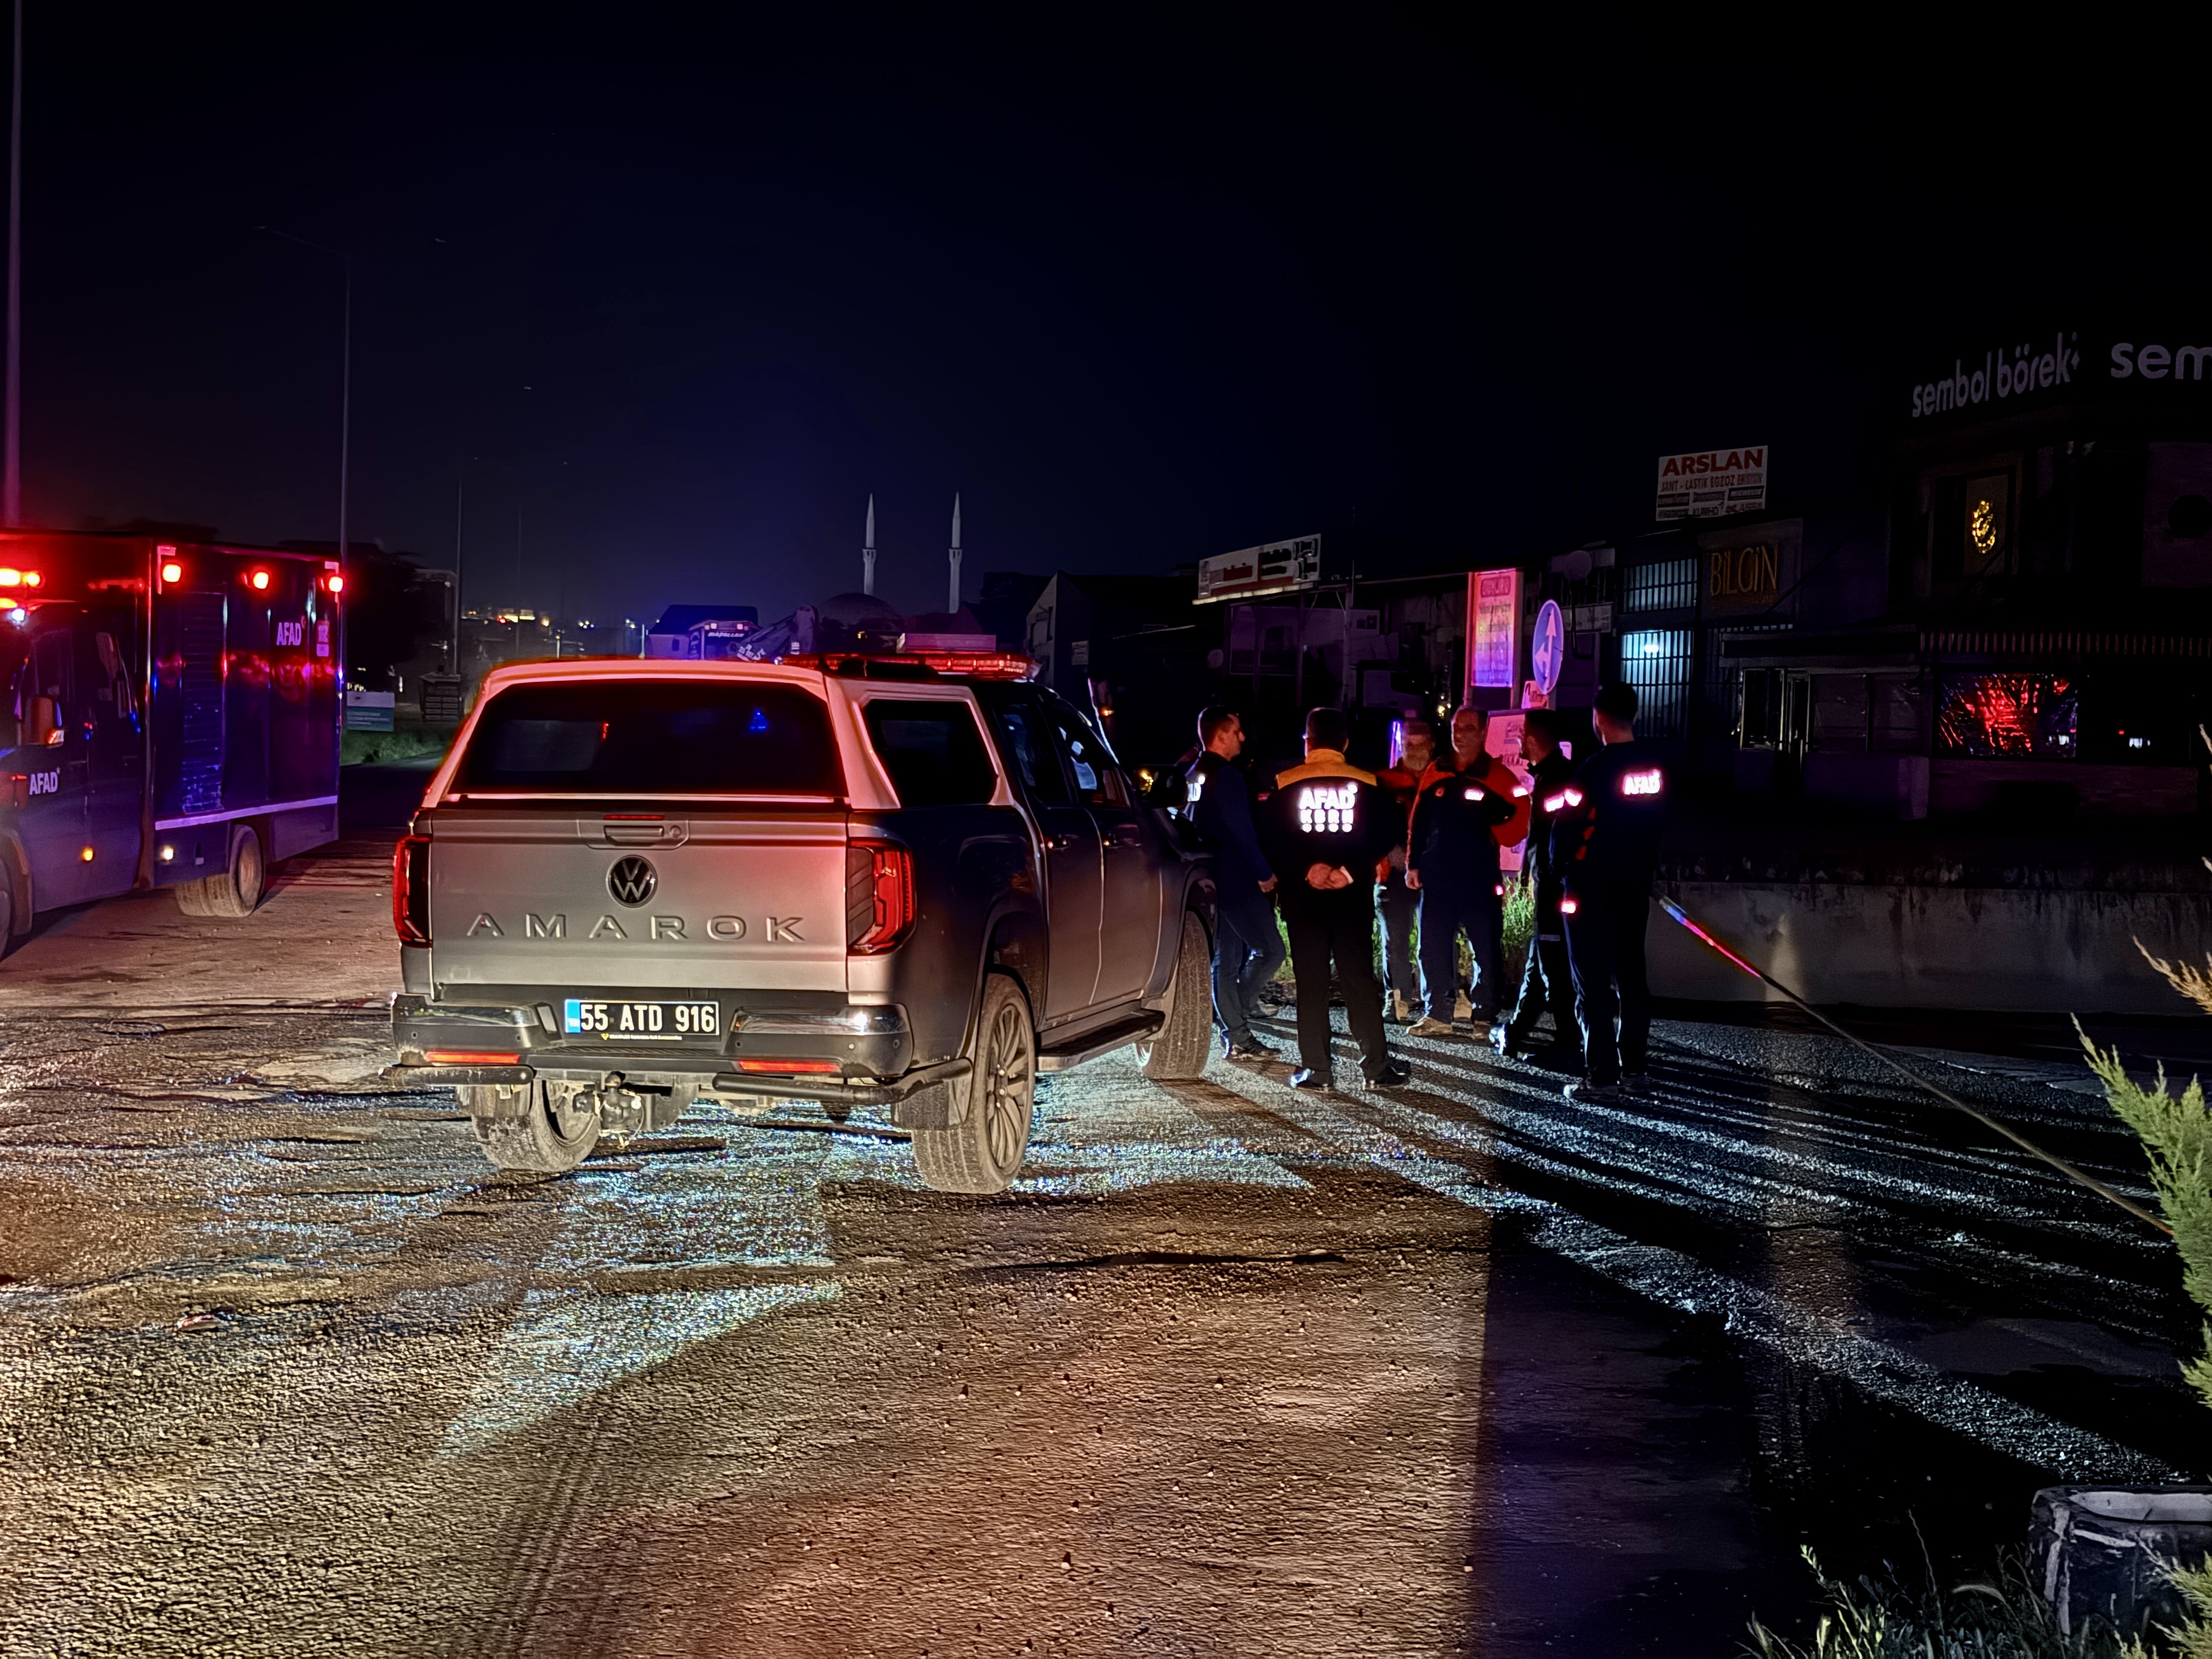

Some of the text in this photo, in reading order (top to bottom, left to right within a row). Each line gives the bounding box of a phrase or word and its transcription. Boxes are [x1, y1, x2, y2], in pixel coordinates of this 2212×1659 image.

[1911, 331, 2072, 418] sembol börek
[1662, 449, 1763, 477] ARSLAN
[1711, 474, 1735, 488] EGZOZ
[276, 622, 302, 646] AFAD
[29, 772, 58, 795] AFAD
[1624, 775, 1661, 795] AFAD
[1300, 787, 1356, 810] AFAD
[1300, 809, 1355, 824] KBRN
[466, 912, 807, 944] AMAROK
[580, 1004, 608, 1031] 55
[619, 1005, 663, 1031] ATD
[675, 1005, 715, 1032] 916
